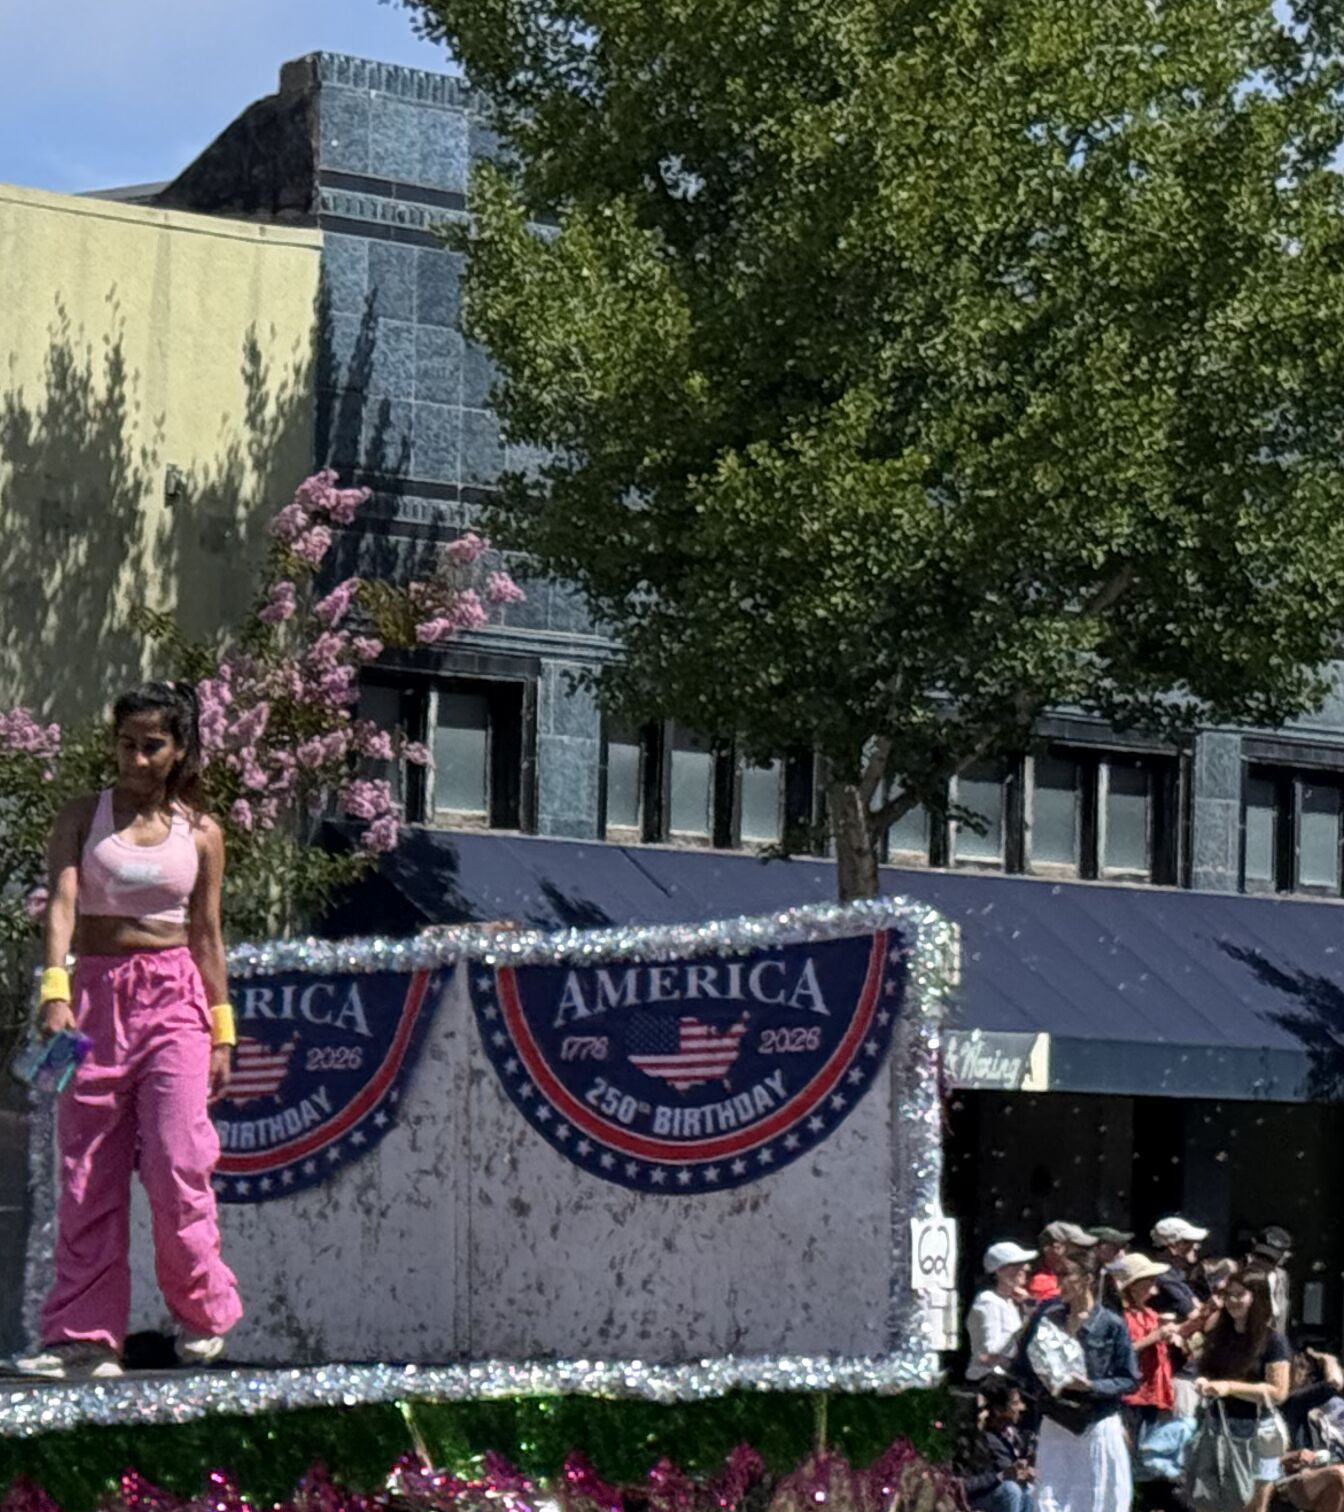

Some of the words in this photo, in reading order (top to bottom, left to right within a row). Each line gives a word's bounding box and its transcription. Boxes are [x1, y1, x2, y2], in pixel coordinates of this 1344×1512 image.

[231, 981, 374, 1038] RICA
[553, 956, 831, 1029] AMERICA
[305, 1045, 365, 1072] 2026
[560, 1035, 610, 1062] 1776
[757, 1026, 822, 1055] 2026
[652, 1067, 790, 1137] BIRTHDAY
